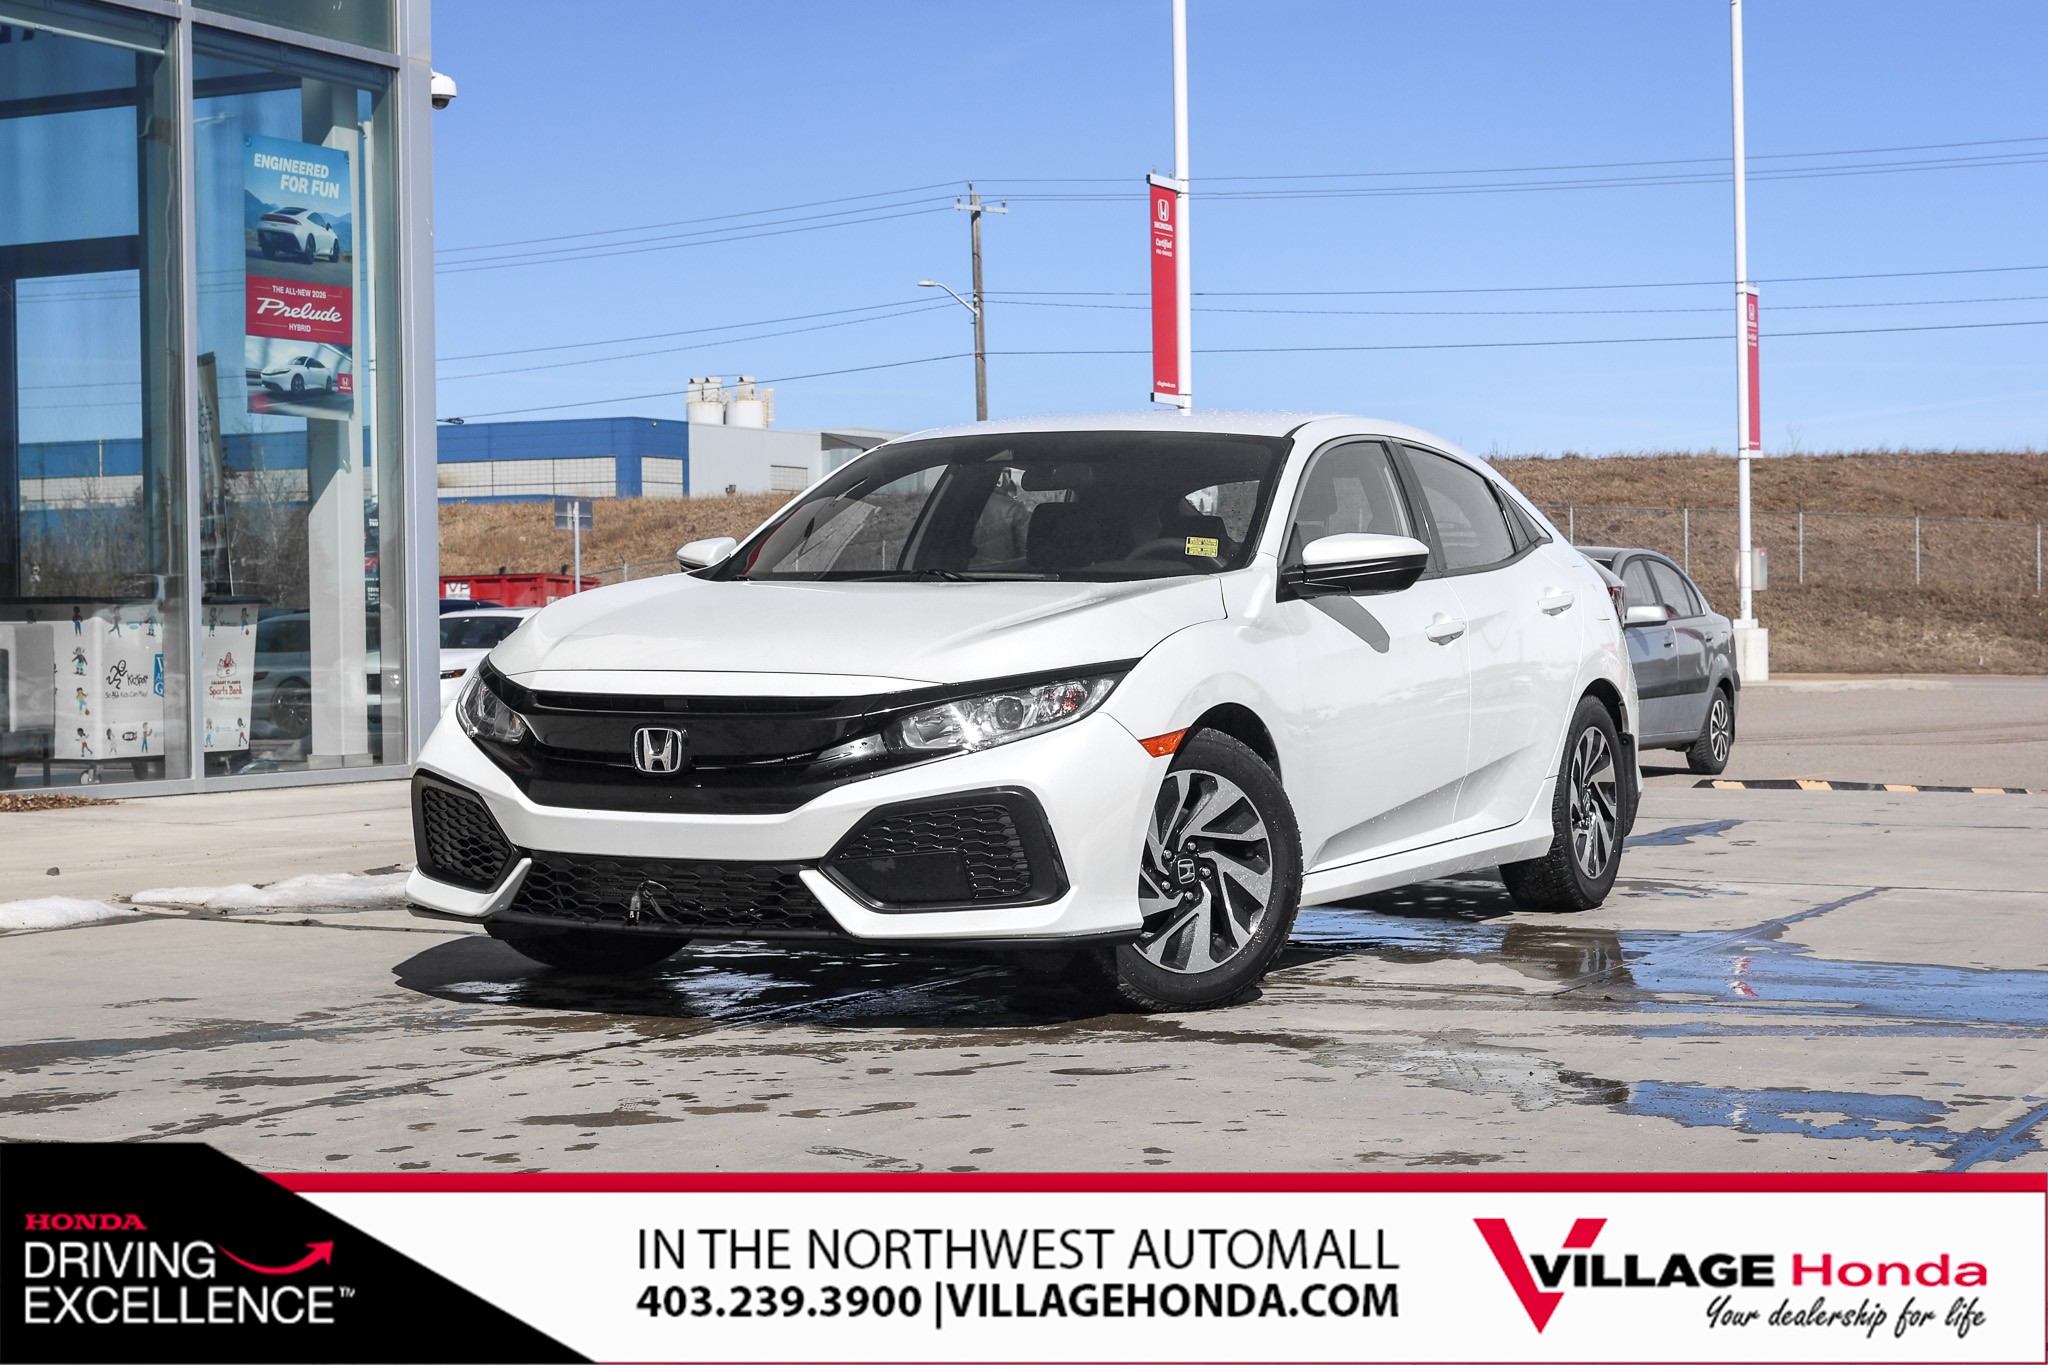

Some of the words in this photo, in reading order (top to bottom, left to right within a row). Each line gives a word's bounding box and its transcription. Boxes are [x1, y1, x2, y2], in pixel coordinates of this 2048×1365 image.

[253, 153, 329, 179] ENGINEERED
[280, 174, 308, 194] FOR
[311, 179, 340, 199] FUN
[272, 285, 284, 294] THE
[285, 287, 311, 297] ALL-NEW
[312, 290, 327, 299] 2026
[256, 297, 343, 323] Prelude
[288, 323, 312, 333] HYBRID
[209, 685, 228, 699] Sports
[229, 685, 243, 696] Bank
